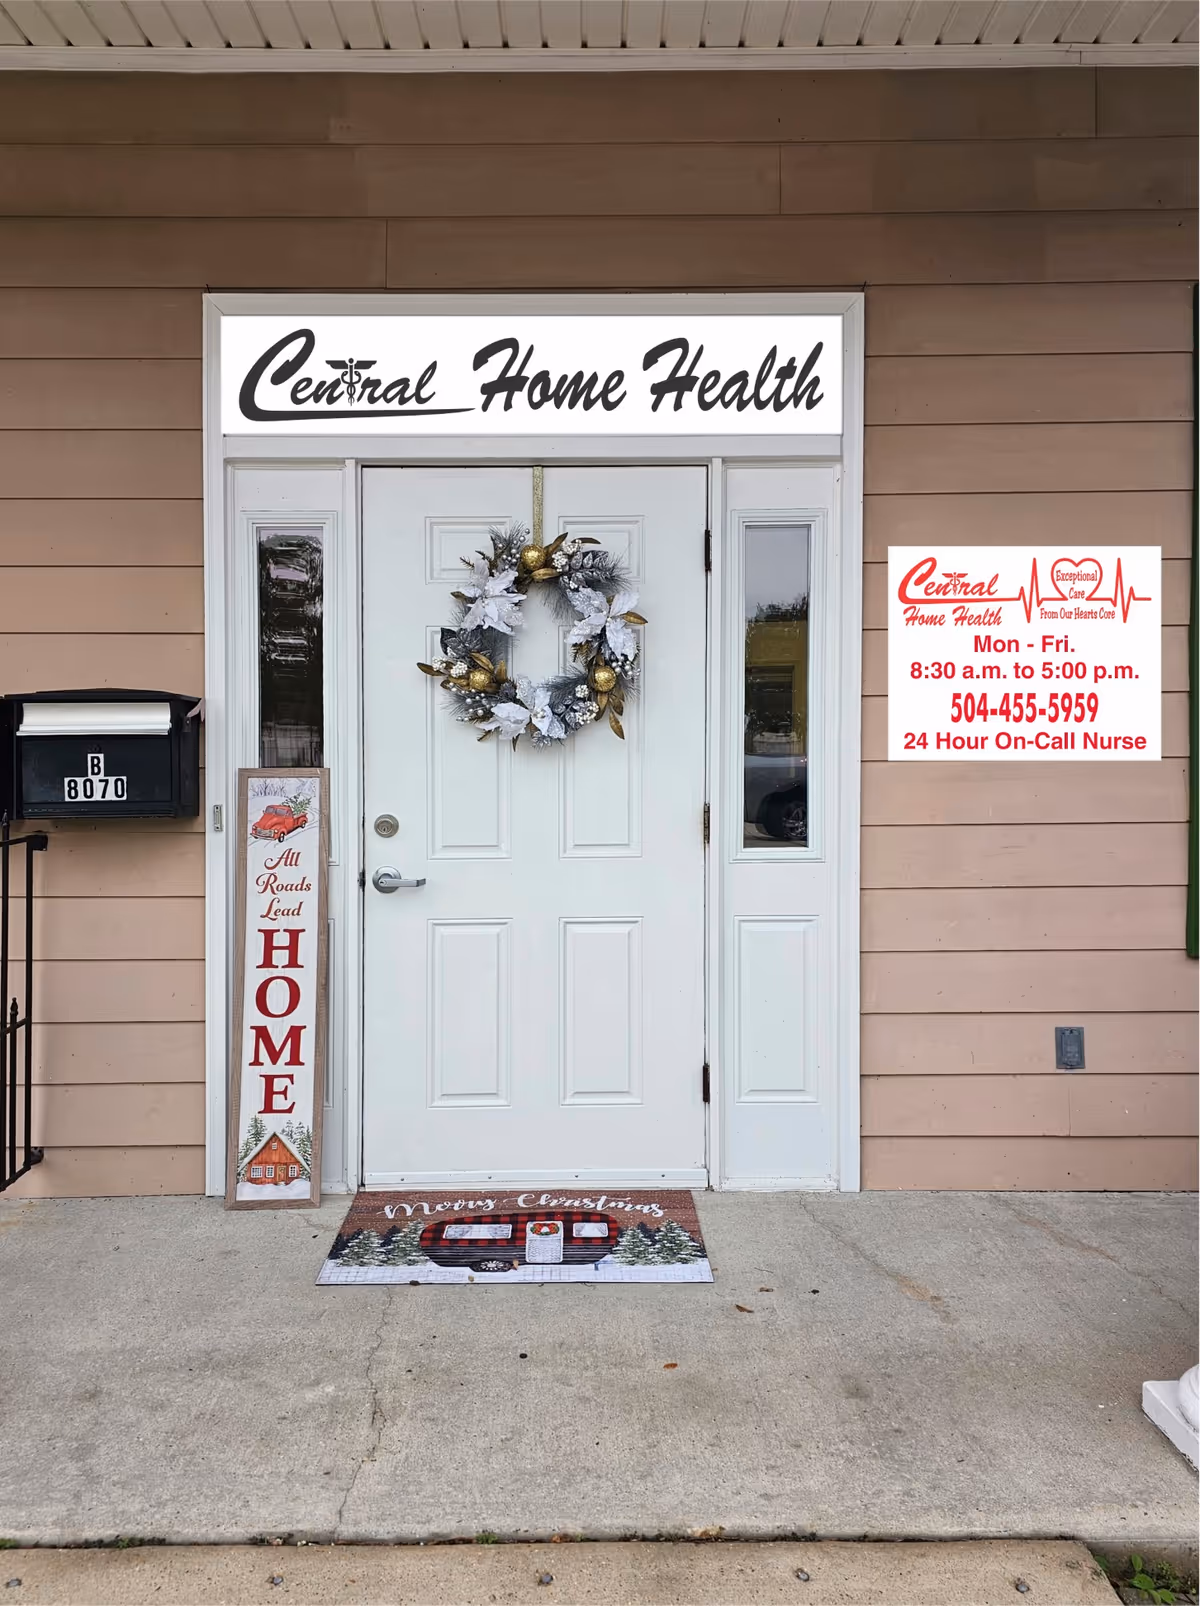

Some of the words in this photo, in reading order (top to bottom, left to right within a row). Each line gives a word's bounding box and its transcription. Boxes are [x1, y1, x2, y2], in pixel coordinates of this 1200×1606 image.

[239, 329, 474, 421] Central
[473, 338, 627, 413] Home
[642, 338, 824, 413] Health
[898, 557, 999, 604] Central
[1055, 570, 1098, 584] Exceptional
[1068, 587, 1086, 600] Care
[903, 605, 946, 626] Home
[952, 605, 1003, 626] Health
[1040, 607, 1059, 620] From
[1059, 607, 1073, 620] Our
[1074, 607, 1098, 620] Hearts
[1099, 607, 1116, 620] Core
[974, 635, 1020, 653] Mon
[1041, 635, 1075, 653] Fri.
[910, 662, 956, 679] 8:30
[962, 665, 1007, 679] a.m.
[1013, 663, 1035, 679] to
[1041, 662, 1087, 679] 5:00
[1093, 665, 1140, 684] p.m.
[950, 692, 1099, 723] 504-455-5959
[903, 732, 929, 750] 24
[936, 732, 989, 750] Hour
[995, 732, 1075, 750] On-Call
[1083, 732, 1147, 750] Nurse
[90, 755, 101, 776] B
[66, 777, 125, 800] 8070
[264, 848, 301, 870] All
[255, 872, 312, 895] Roads
[260, 897, 303, 921] Lead
[249, 928, 306, 1114] HOME
[376, 1198, 497, 1219] Merry
[513, 1193, 667, 1218] Christmas
